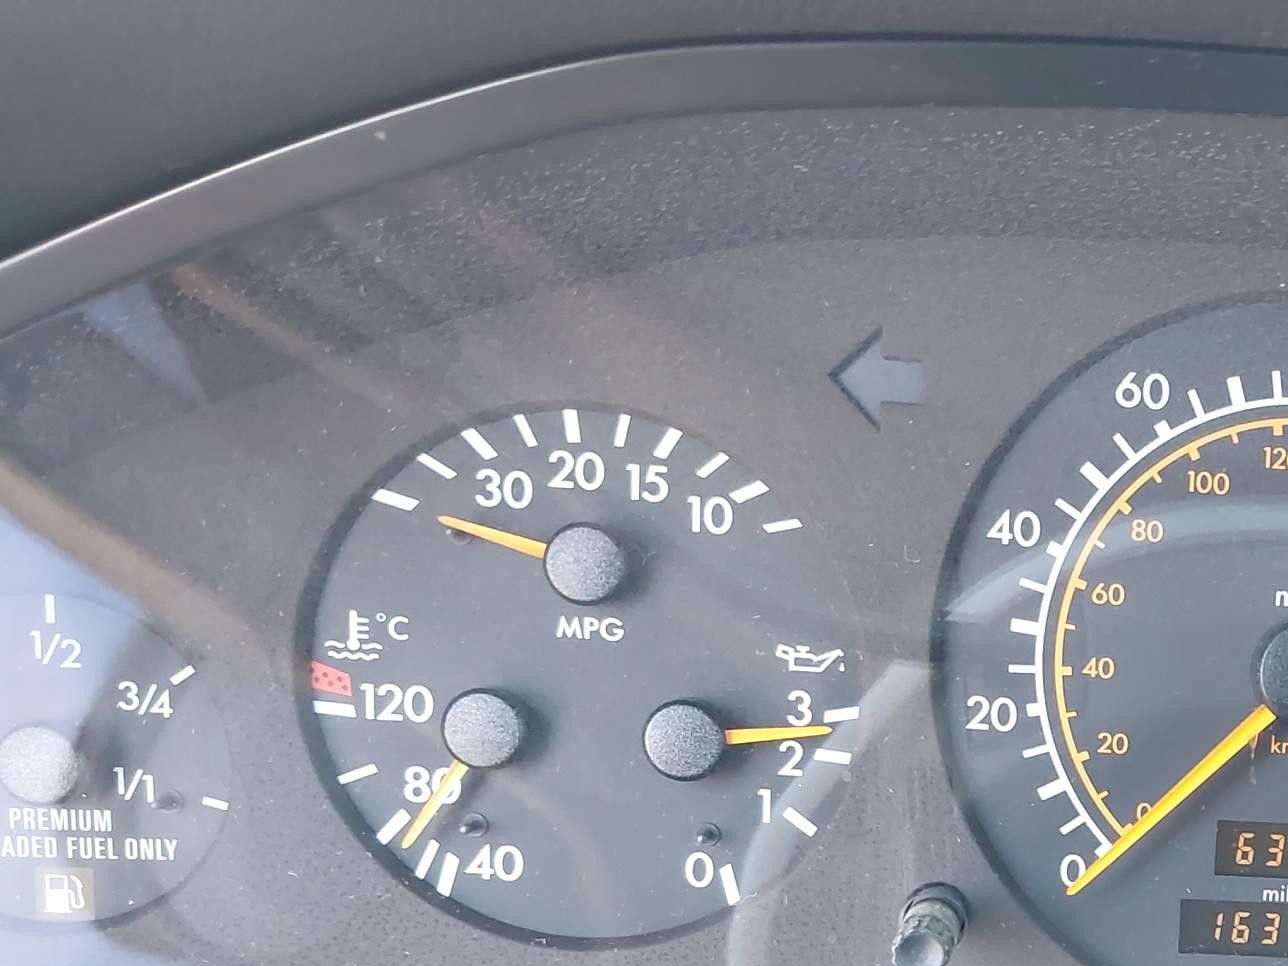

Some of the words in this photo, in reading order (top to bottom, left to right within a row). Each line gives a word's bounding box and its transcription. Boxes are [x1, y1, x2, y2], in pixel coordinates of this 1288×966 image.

[1115, 372, 1170, 410] 60
[475, 469, 533, 509] 30
[548, 452, 605, 490] 20
[625, 464, 669, 502] 15
[1187, 471, 1230, 495] 100
[687, 496, 734, 535] 10
[986, 510, 1041, 549] 40
[1130, 520, 1164, 544] 80
[1091, 583, 1126, 607] 60
[556, 616, 625, 642] MPG
[30, 630, 82, 669] 1/2
[1081, 657, 1115, 680] 40
[116, 681, 174, 718] 3/4
[359, 683, 434, 723] 120
[787, 690, 813, 726] 3
[965, 695, 1017, 732] 20
[777, 742, 804, 777] 2
[1097, 733, 1129, 755] 20
[113, 766, 156, 803] 1/1
[8, 807, 113, 832] PREMIUM
[756, 788, 773, 824] 1
[66, 836, 119, 860] FUEL
[124, 838, 178, 861] ONLY
[464, 844, 525, 881] 40
[684, 851, 715, 887] 0
[1060, 854, 1087, 888] 0
